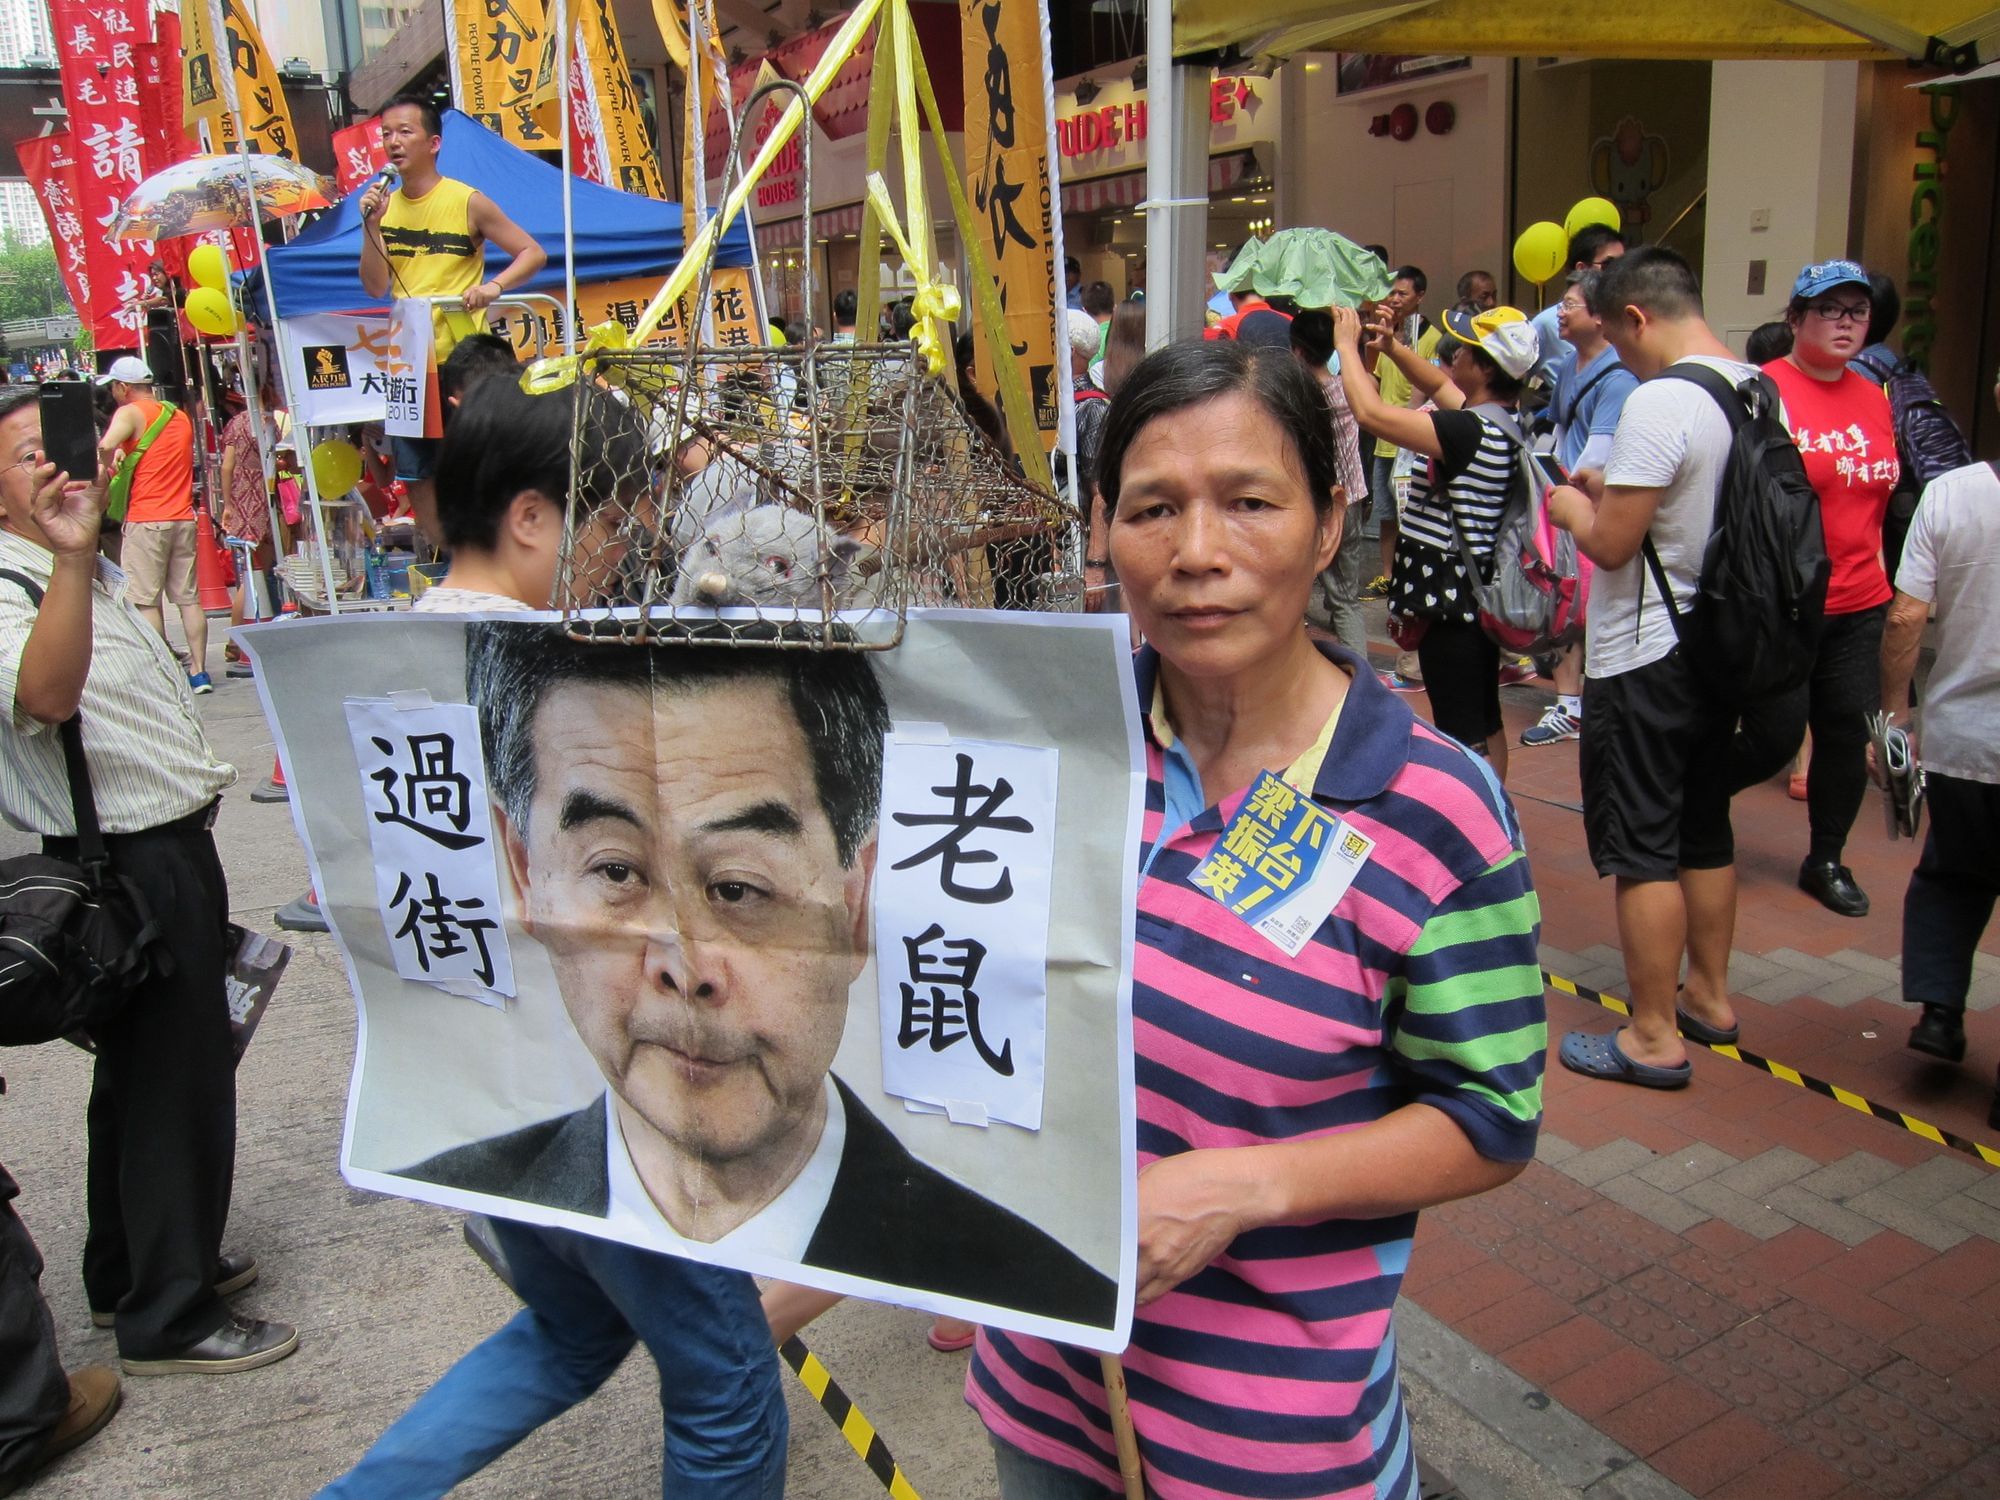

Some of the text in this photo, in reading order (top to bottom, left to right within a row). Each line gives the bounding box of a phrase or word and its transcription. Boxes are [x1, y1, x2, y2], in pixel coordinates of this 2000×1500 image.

[67, 23, 107, 106] 長毛
[103, 8, 141, 106] 社民連
[468, 22, 485, 111] PEOPLE POWER
[603, 67, 631, 163] PEOPLE POWER
[758, 180, 797, 207] HOUSE
[388, 405, 419, 421] 2015
[370, 732, 499, 988] 過街
[1194, 774, 1297, 902] 梁振英
[890, 752, 1035, 1077] 老鼠
